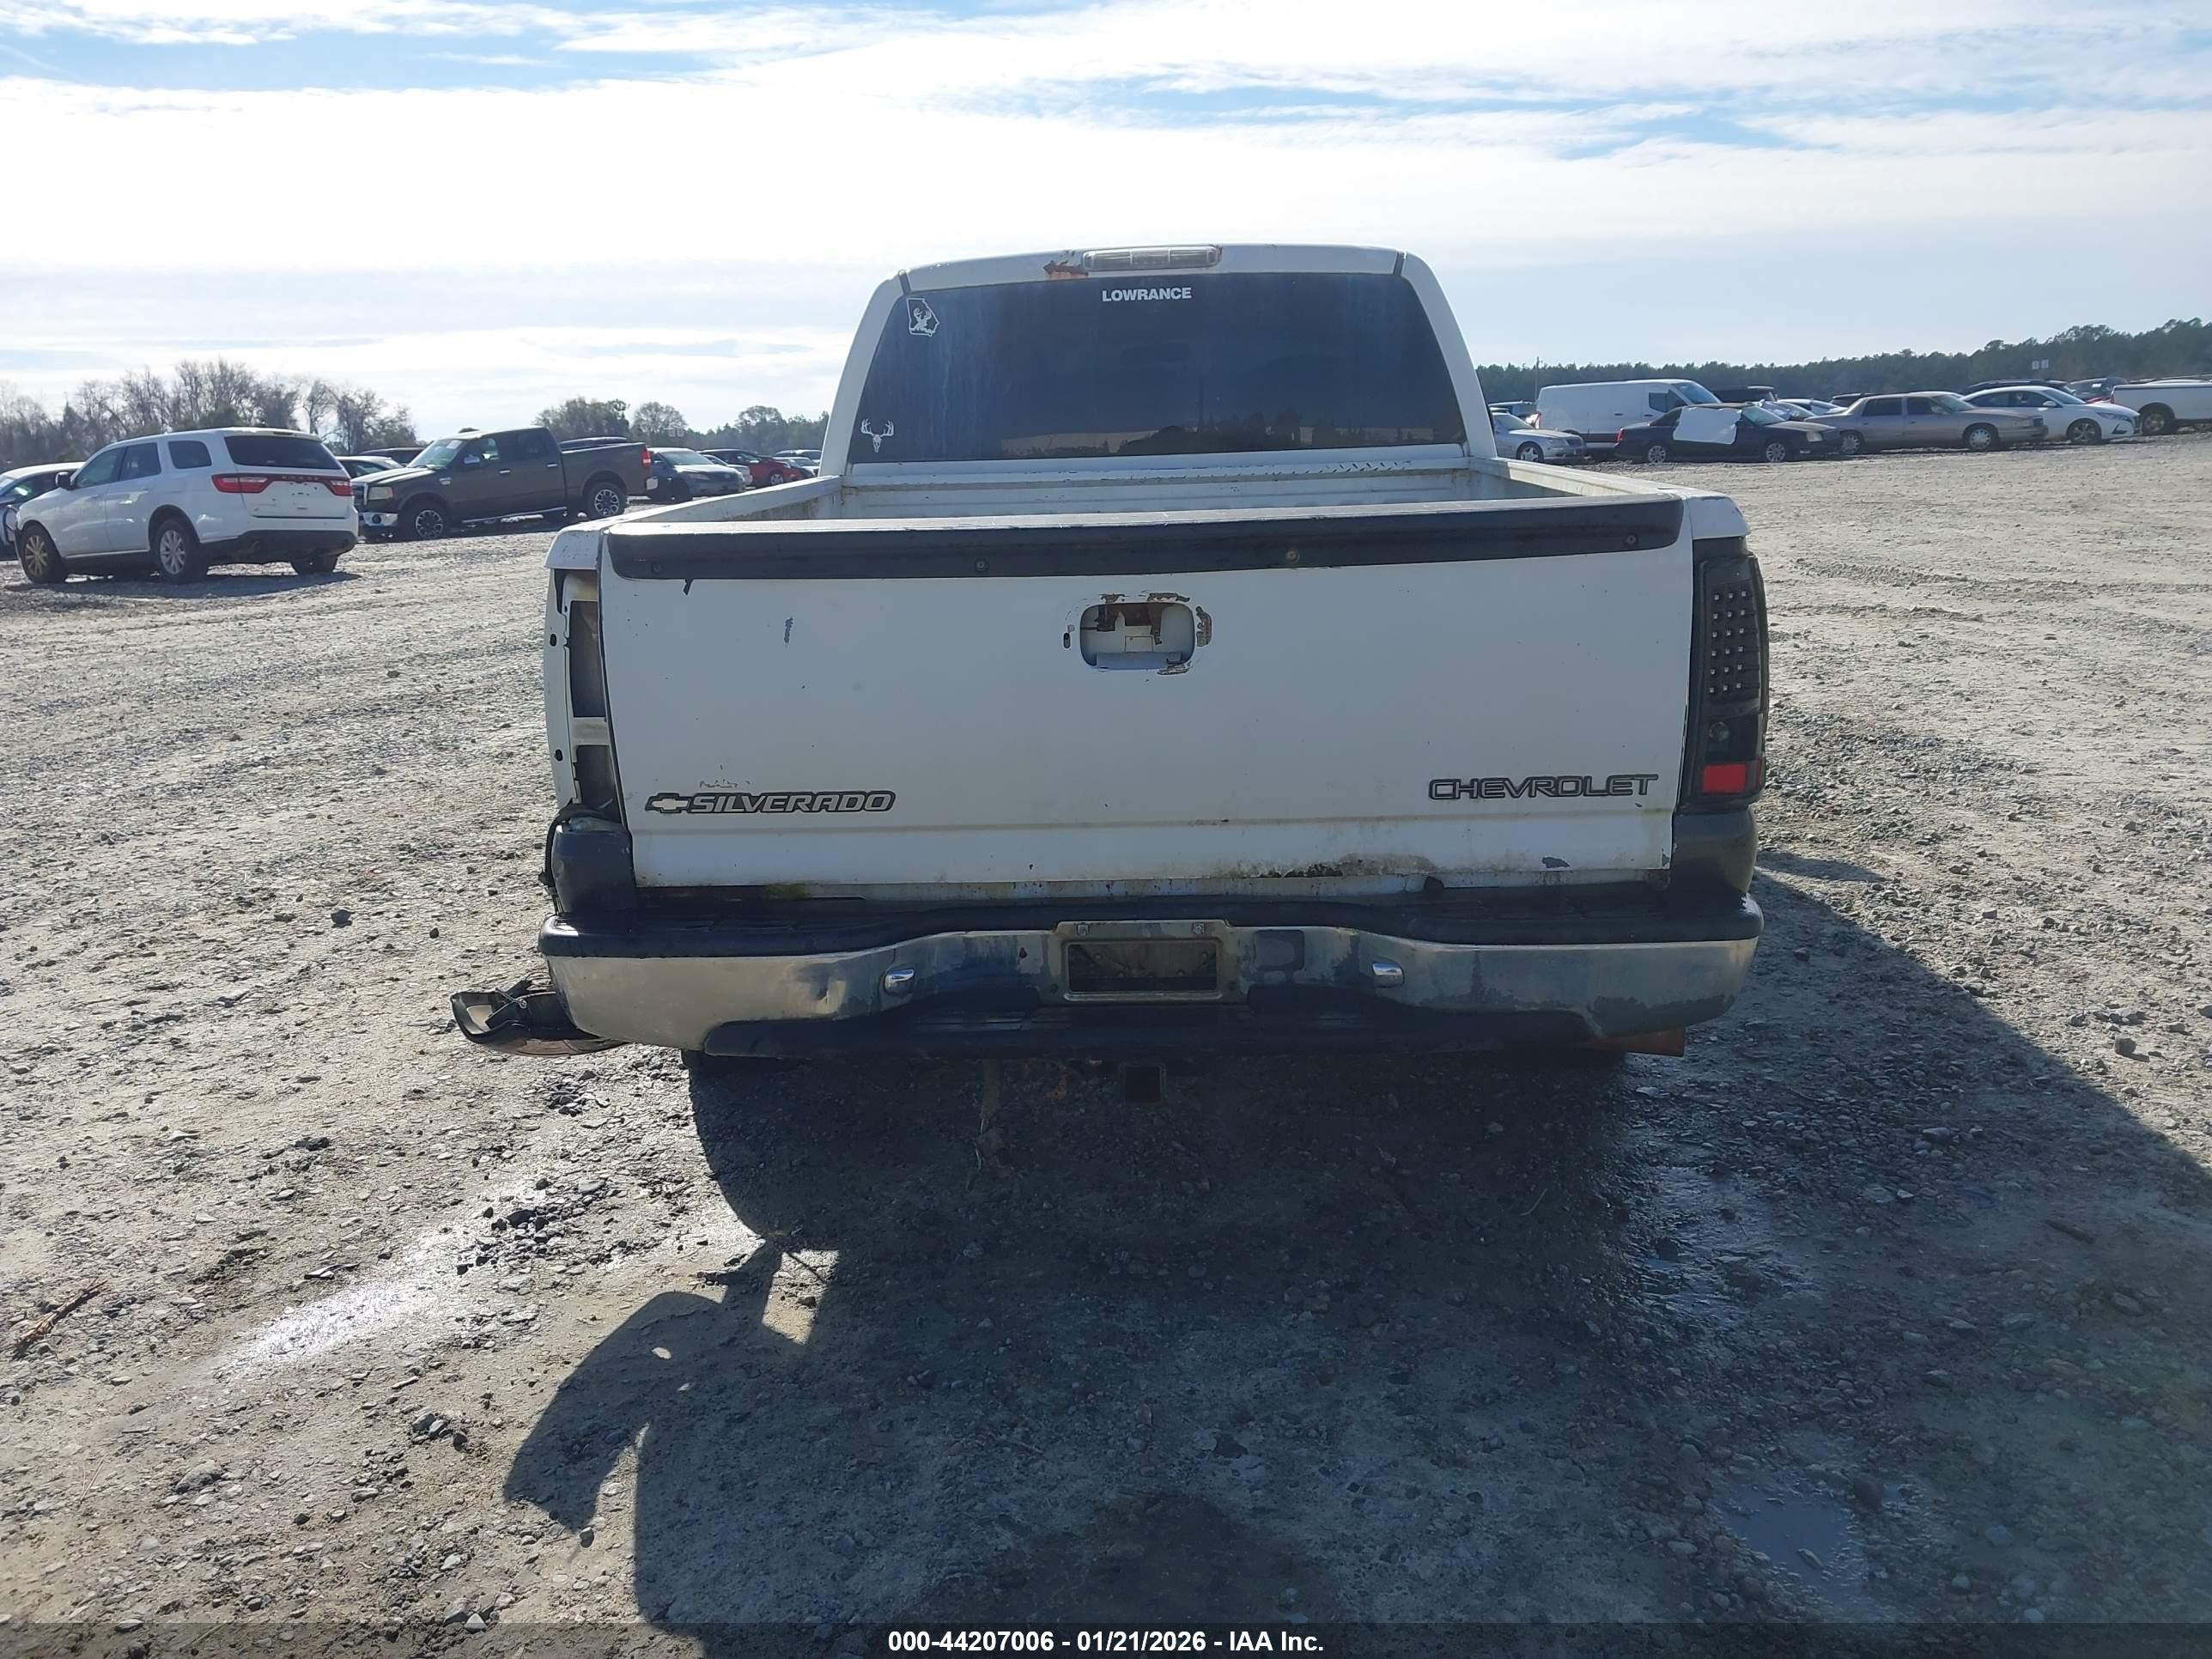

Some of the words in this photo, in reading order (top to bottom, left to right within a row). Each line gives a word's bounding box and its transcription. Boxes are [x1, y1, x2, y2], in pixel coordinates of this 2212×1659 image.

[1102, 288, 1192, 301] LOWRANCE
[1429, 774, 1658, 799] CHEVROLET
[689, 792, 896, 813] SILVERADO
